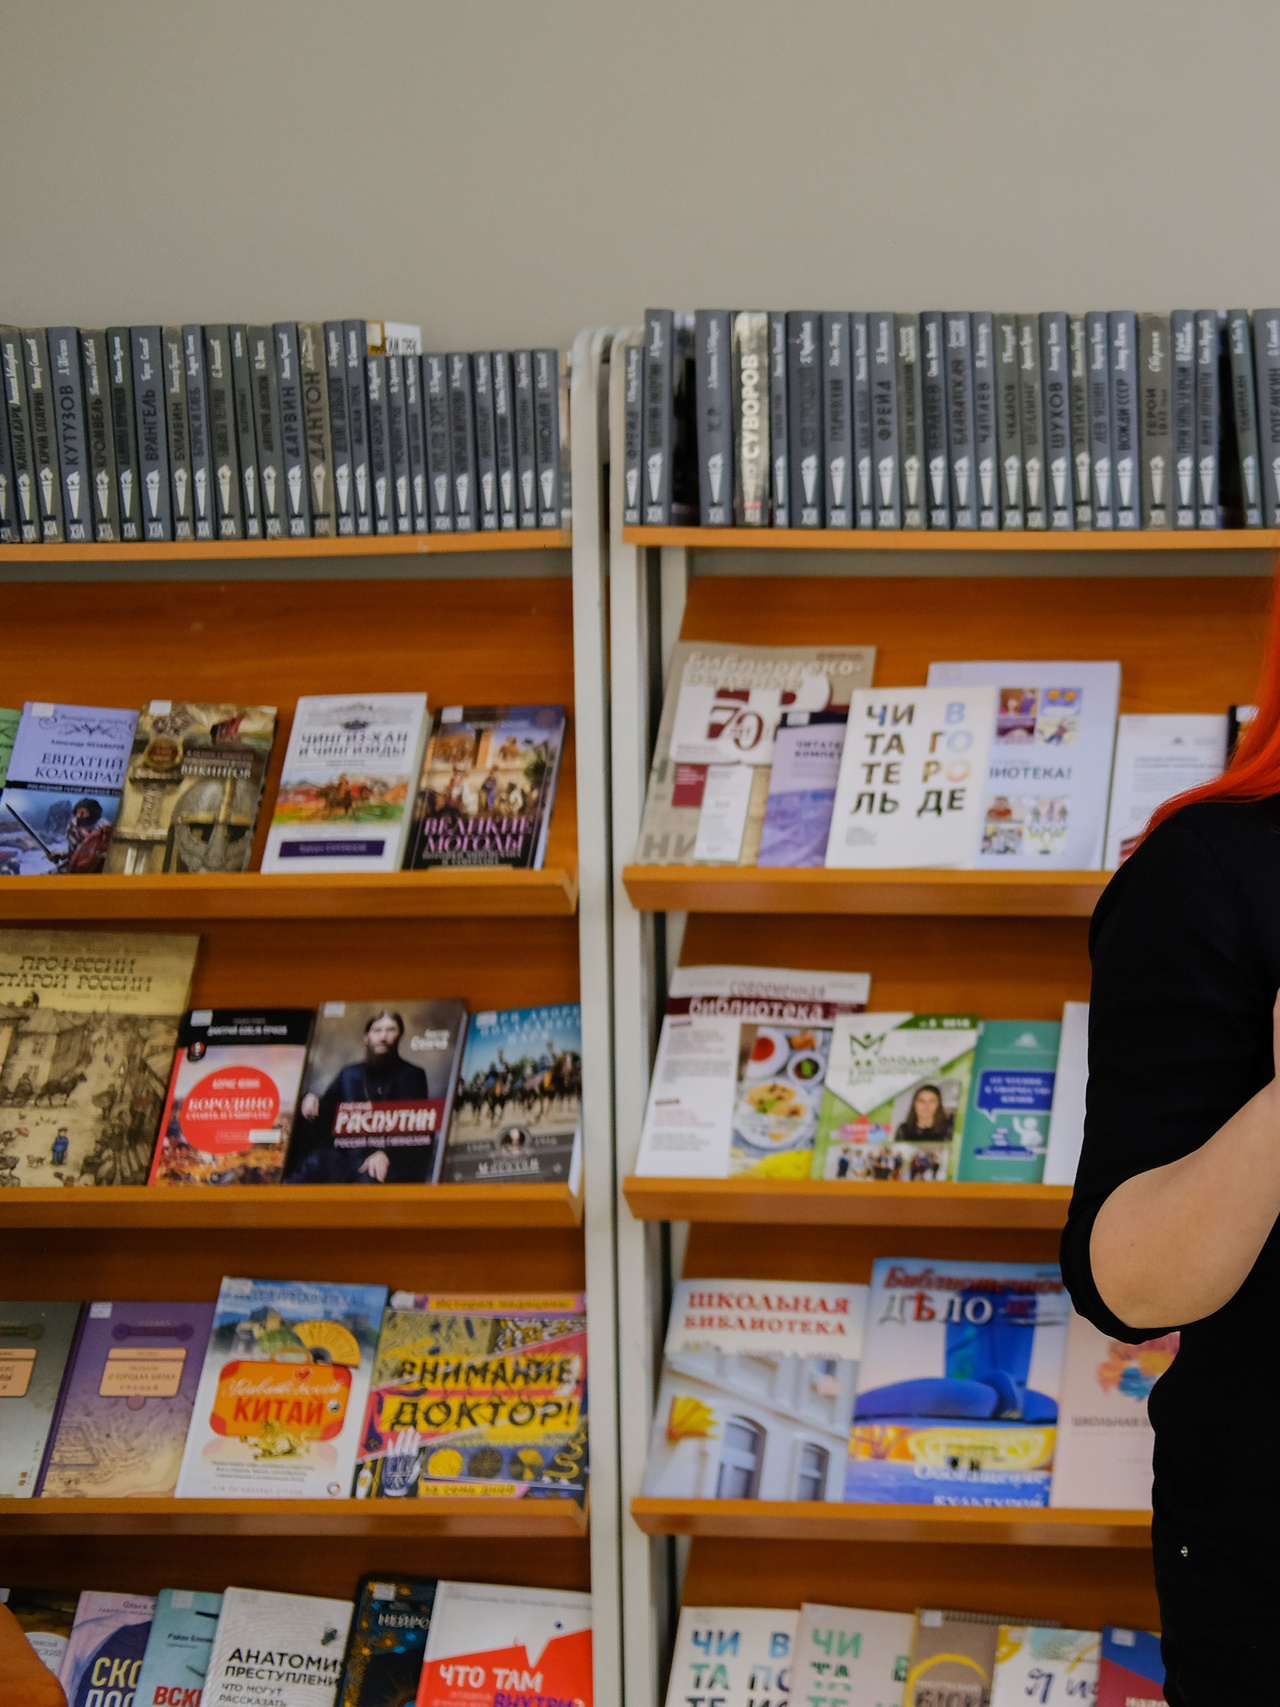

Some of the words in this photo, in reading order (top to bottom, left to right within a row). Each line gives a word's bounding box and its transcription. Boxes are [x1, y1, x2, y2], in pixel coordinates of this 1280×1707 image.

[951, 360, 967, 445] БЛАВАТСКАЯ
[1092, 382, 1106, 417] ЯШИН
[1117, 378, 1130, 405] СССР
[304, 370, 325, 462] ДАНТОН
[741, 353, 760, 460] СУВОРОВ
[875, 381, 892, 441] ФРЕЙД
[977, 382, 991, 443] ЧАПАЕВ
[1005, 383, 1017, 439] ЧКАЛОВ
[1049, 382, 1065, 449] ШУХОВ
[1072, 384, 1085, 445] ЭПИКУР
[1146, 388, 1158, 437] ГЕРОИ
[59, 385, 78, 465] КУТУЗОВ
[91, 398, 106, 468] КРОМВЕЛЬ
[142, 389, 159, 461] ВРАНГЕЛЬ
[172, 402, 185, 461] БУЛАВИН
[282, 386, 300, 458] ДАРВИН
[1094, 422, 1107, 444] ЛЕВ
[1119, 408, 1131, 451] ВОЖДИ
[707, 706, 764, 750] 70
[866, 703, 916, 726] ЧИ
[945, 702, 966, 724] В
[300, 732, 408, 745] ЧИНГИЗ-ХАН
[865, 733, 906, 755] ТА
[928, 730, 974, 754] ГО
[42, 752, 124, 769] ЕВПАТИЙ
[862, 762, 902, 785] ТЕ
[922, 760, 971, 783] РО
[35, 767, 124, 784] КОЛОВРАТ
[850, 792, 899, 816] ЛЬ
[917, 788, 967, 818] ДЕ
[424, 817, 533, 836] ВЕЛИКИЕ
[425, 834, 524, 852] МОГОЛЫ
[19, 955, 136, 973] ПРОФЕССИИ
[77, 976, 153, 992] РОССИИ
[689, 996, 823, 1020] библиотека
[187, 1095, 274, 1111] БОРОДИНО
[335, 1108, 436, 1134] РАСПУТИН
[688, 1291, 851, 1315] ШКОЛЬНАЯ
[684, 1316, 847, 1336] БИБЛИОТЕКА
[232, 1396, 326, 1426] КИТАЙ
[390, 1401, 573, 1431] ДОКТОР!
[692, 1629, 741, 1657] ЧИ
[769, 1632, 790, 1658] В
[812, 1628, 862, 1659] ЧИ
[222, 1683, 242, 1693] ЧТО
[246, 1685, 283, 1696] МОГУТ
[439, 1664, 486, 1688] ЧТО
[492, 1667, 544, 1693] ТАМ
[690, 1663, 730, 1690] ТА
